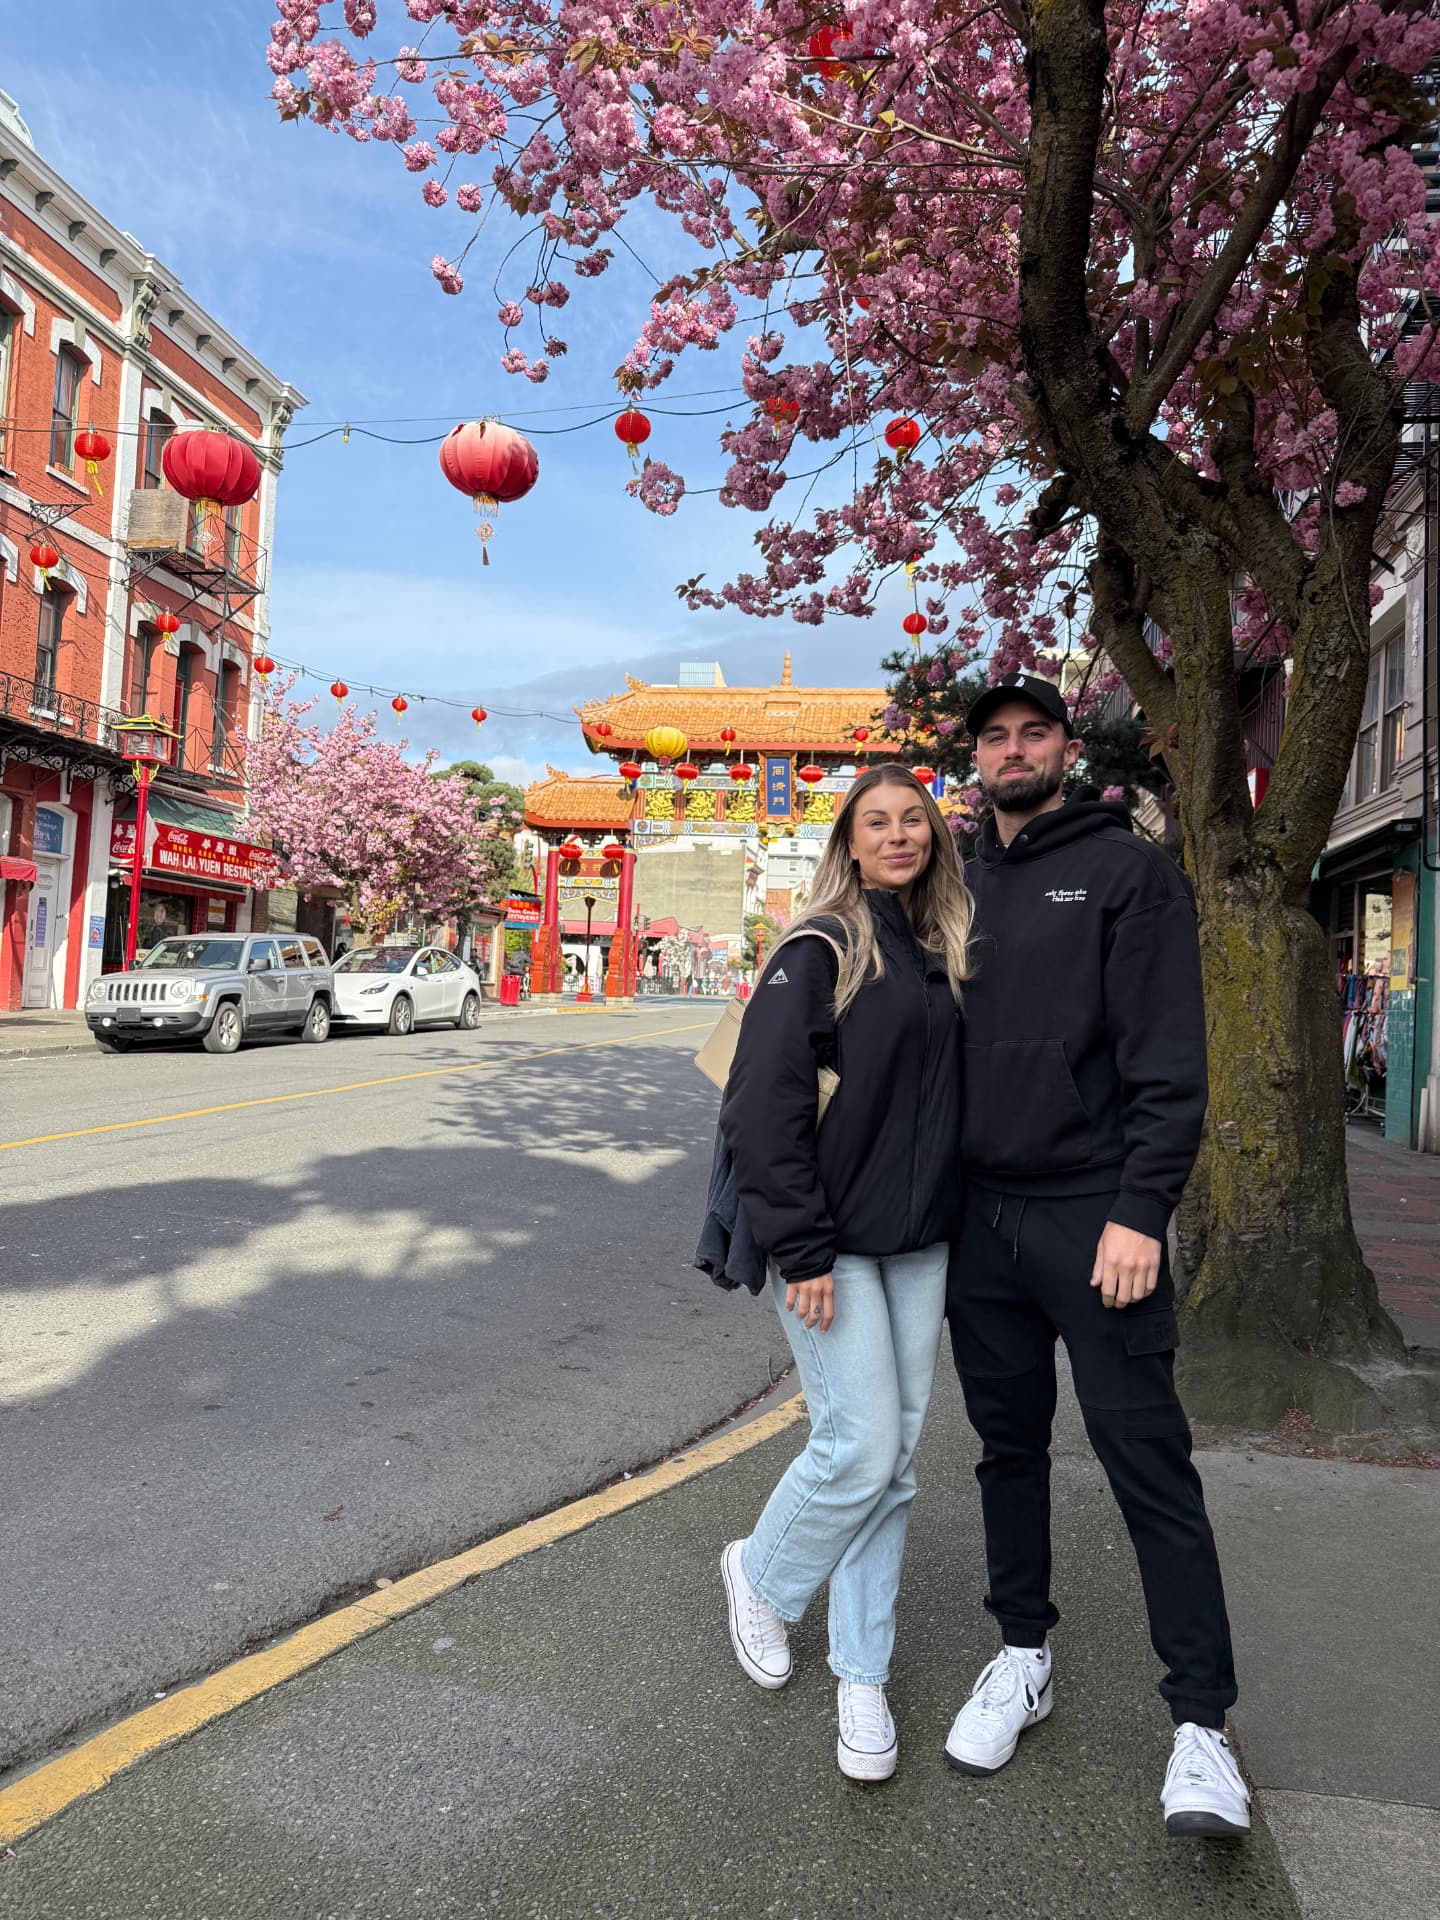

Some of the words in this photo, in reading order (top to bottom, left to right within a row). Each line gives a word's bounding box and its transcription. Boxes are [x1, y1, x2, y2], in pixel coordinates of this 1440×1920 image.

[160, 849, 180, 868] WAH
[182, 853, 197, 871] LAI
[199, 857, 221, 875] YUEN
